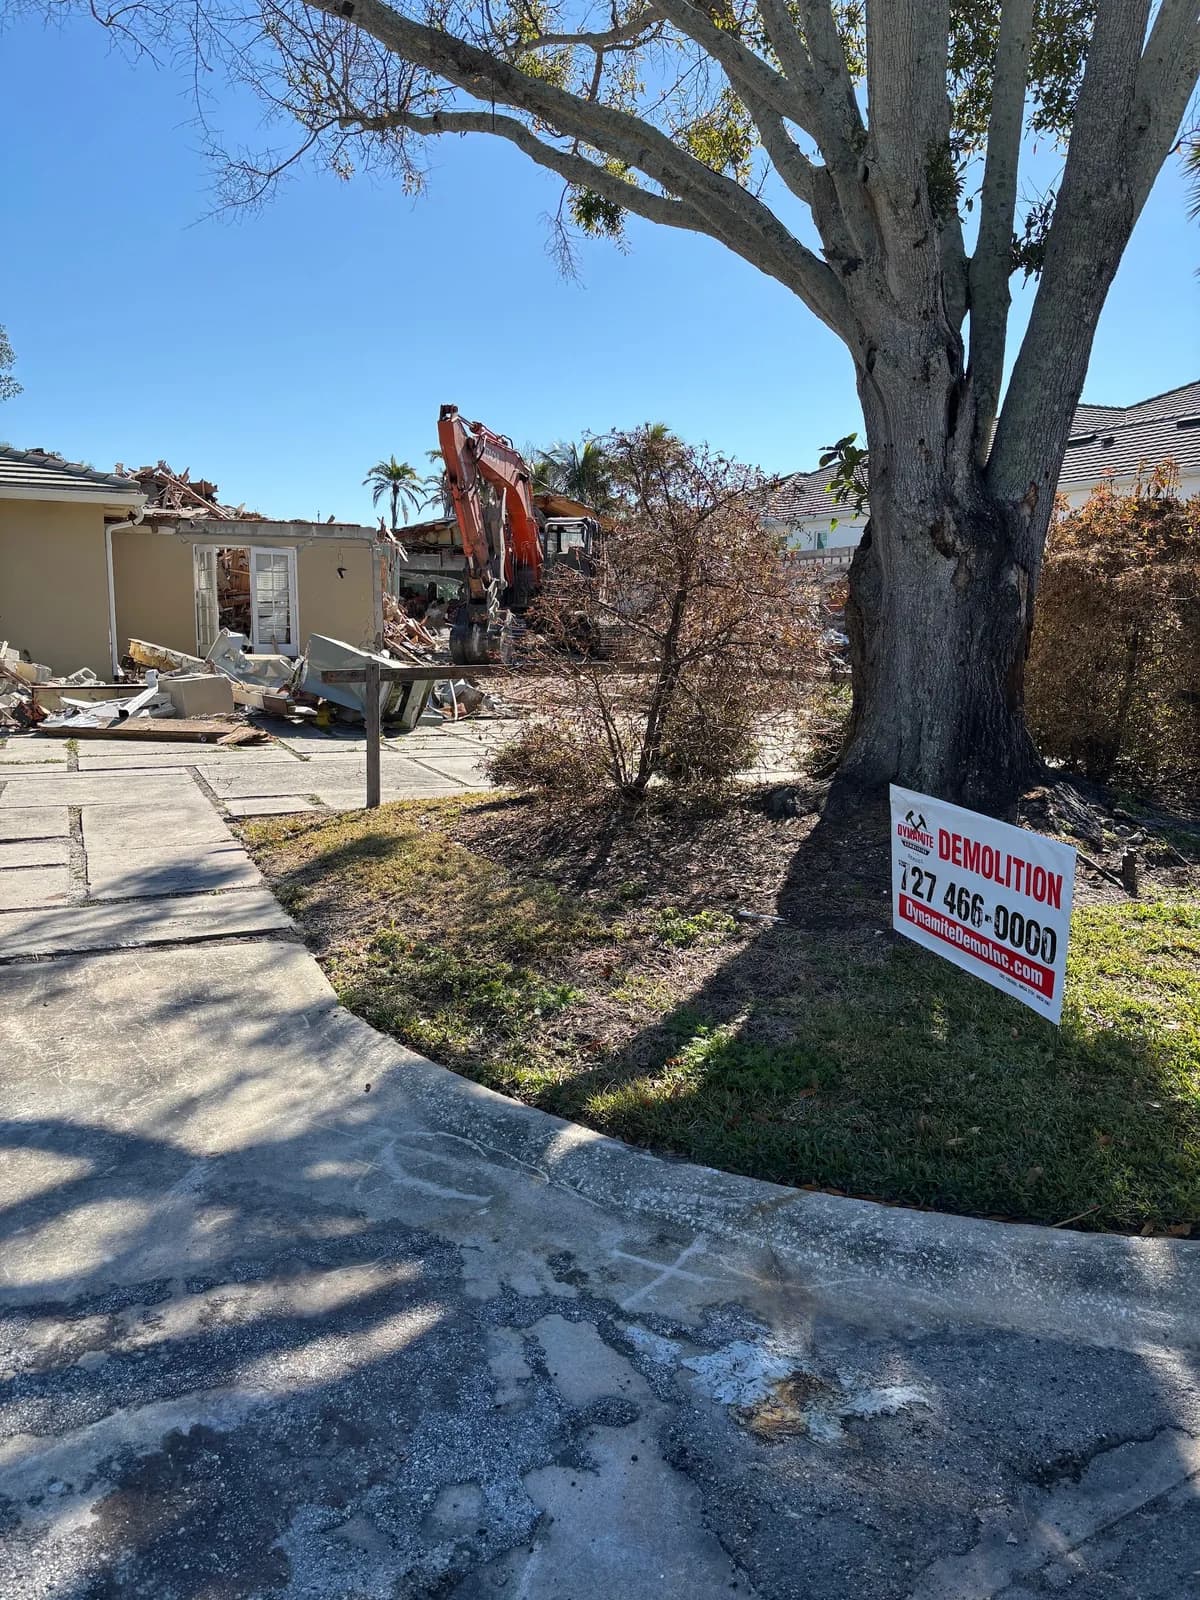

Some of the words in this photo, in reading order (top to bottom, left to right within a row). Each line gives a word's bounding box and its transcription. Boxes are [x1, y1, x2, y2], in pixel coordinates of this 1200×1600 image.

[898, 859, 936, 904] 727
[943, 882, 1057, 966] 466-0000
[938, 828, 1063, 910] DEMOLITION
[906, 899, 1043, 987] DynamiteDemoInc.com
